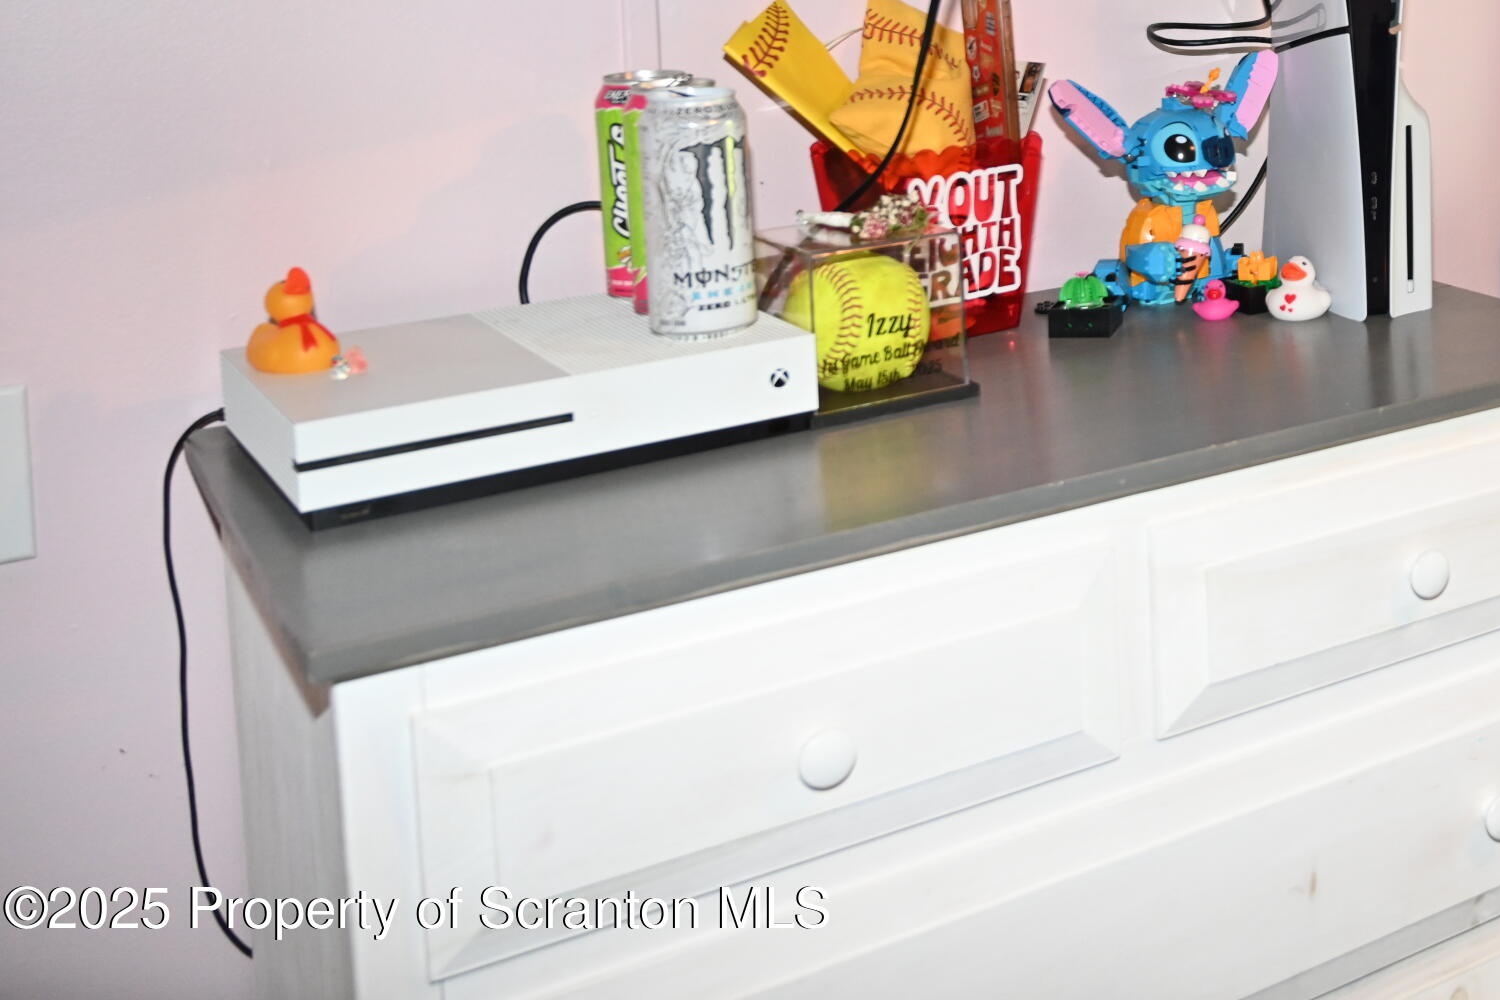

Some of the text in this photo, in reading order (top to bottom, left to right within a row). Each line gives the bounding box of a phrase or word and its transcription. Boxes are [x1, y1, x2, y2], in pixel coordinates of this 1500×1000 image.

[919, 248, 1018, 302] RADE
[867, 312, 914, 338] Izzy
[883, 343, 910, 361] Ball
